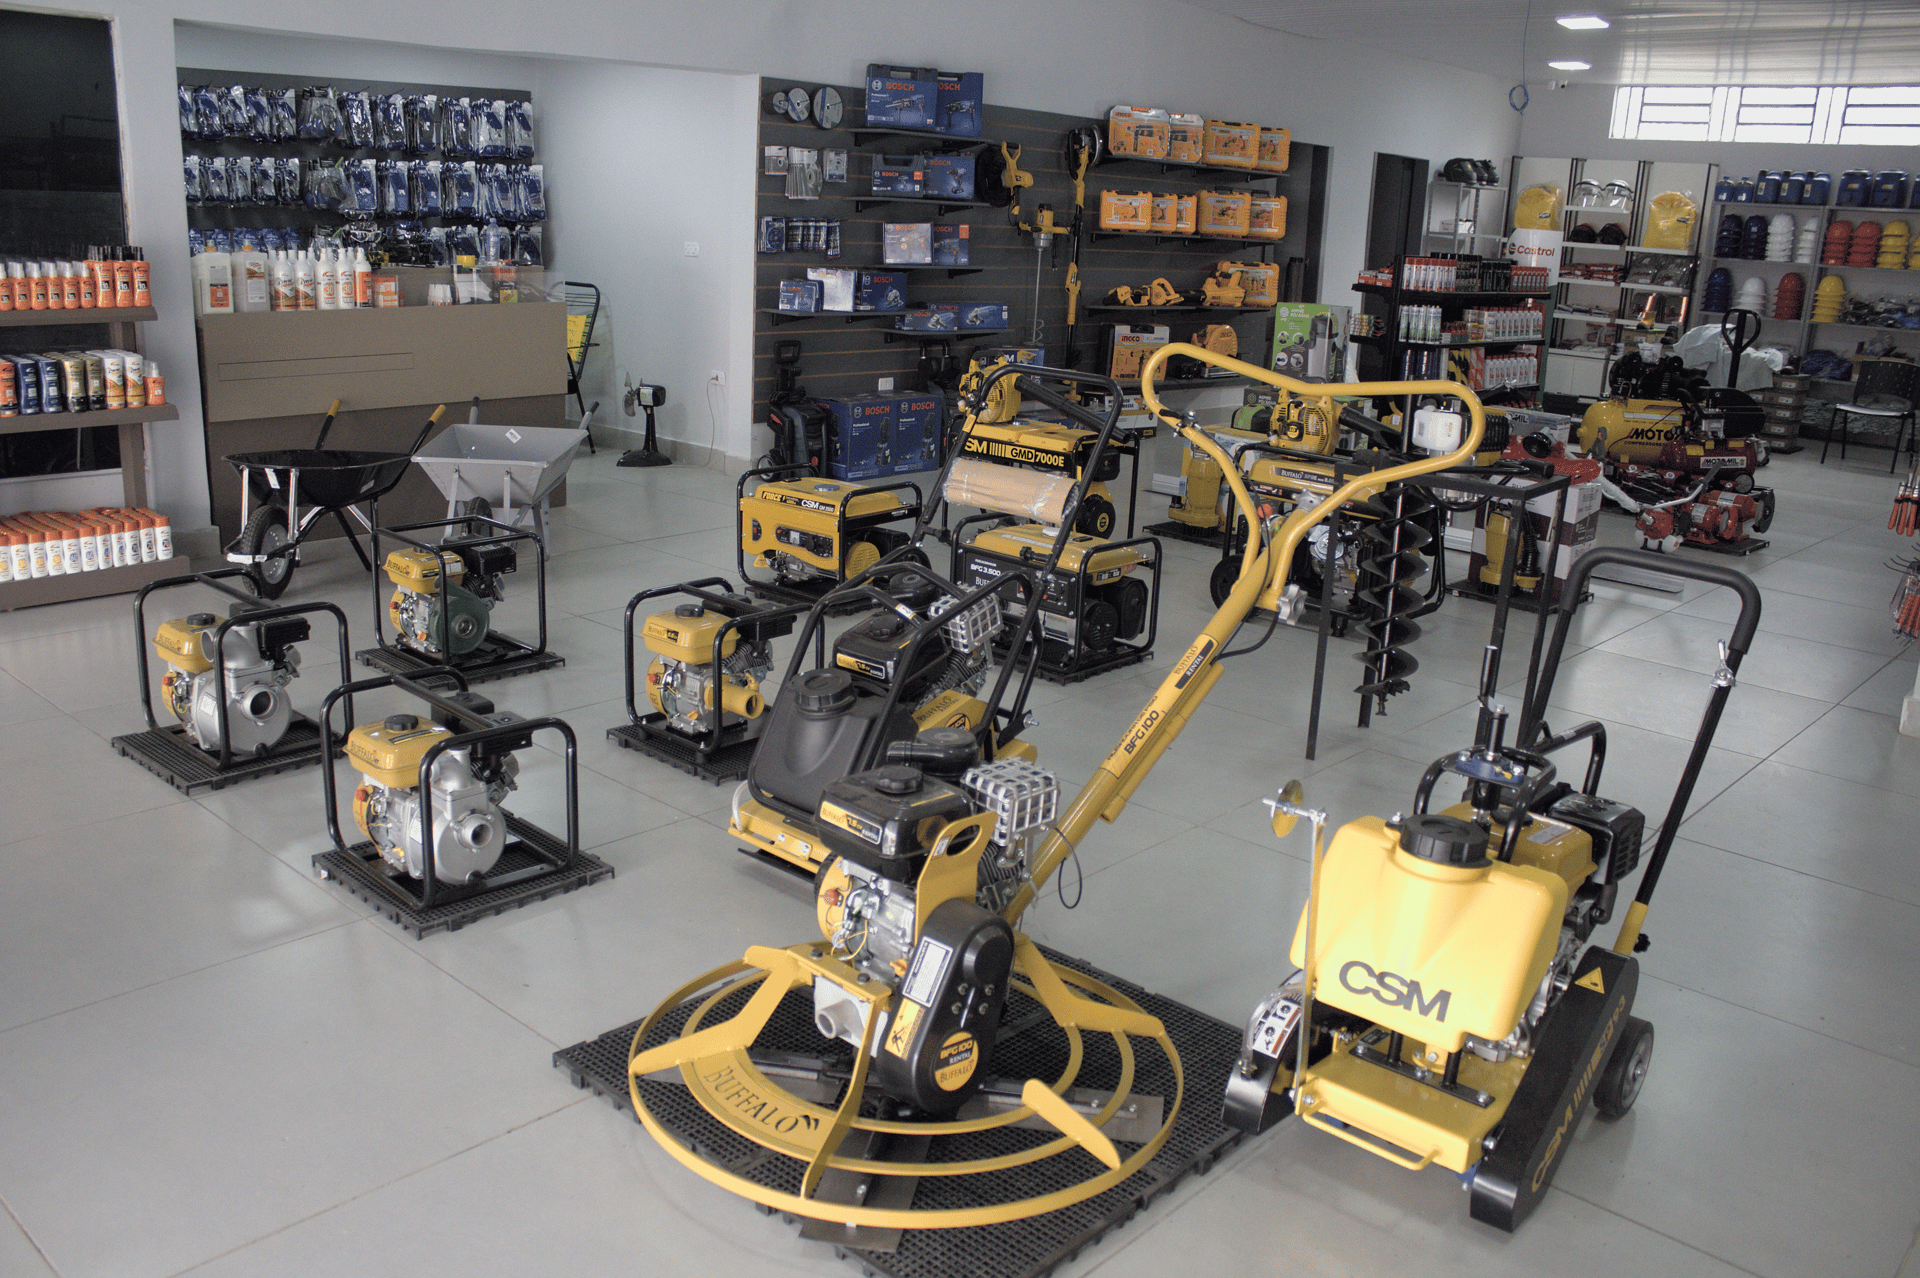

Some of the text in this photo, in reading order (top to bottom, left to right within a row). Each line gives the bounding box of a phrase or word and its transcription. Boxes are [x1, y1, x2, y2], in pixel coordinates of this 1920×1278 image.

[885, 82, 915, 92] BOSCH
[937, 82, 961, 91] OSCH
[929, 159, 952, 167] BOSCH
[1517, 245, 1556, 256] Castrol
[873, 276, 894, 284] BOSCH
[865, 405, 890, 416] BOSCH
[911, 401, 936, 411] BOSCH
[1010, 447, 1034, 461] GMD
[1035, 451, 1065, 468] 7000E
[1281, 469, 1303, 480] BUFFALO
[762, 491, 782, 502] FORCE
[801, 499, 819, 510] CSM
[970, 563, 1002, 577] BFG 3.500
[1174, 645, 1199, 675] BUFFALO
[1185, 654, 1205, 677] RENTAL
[1123, 709, 1160, 755] BFG 100
[847, 817, 858, 828] 7.5
[1338, 959, 1453, 1023] CSM
[940, 1039, 973, 1060] BFG 100
[949, 1051, 971, 1065] RENTAL
[940, 1063, 973, 1083] BUFFALO
[703, 1064, 800, 1134] BUFFALO
[1530, 1104, 1575, 1194] CSM
